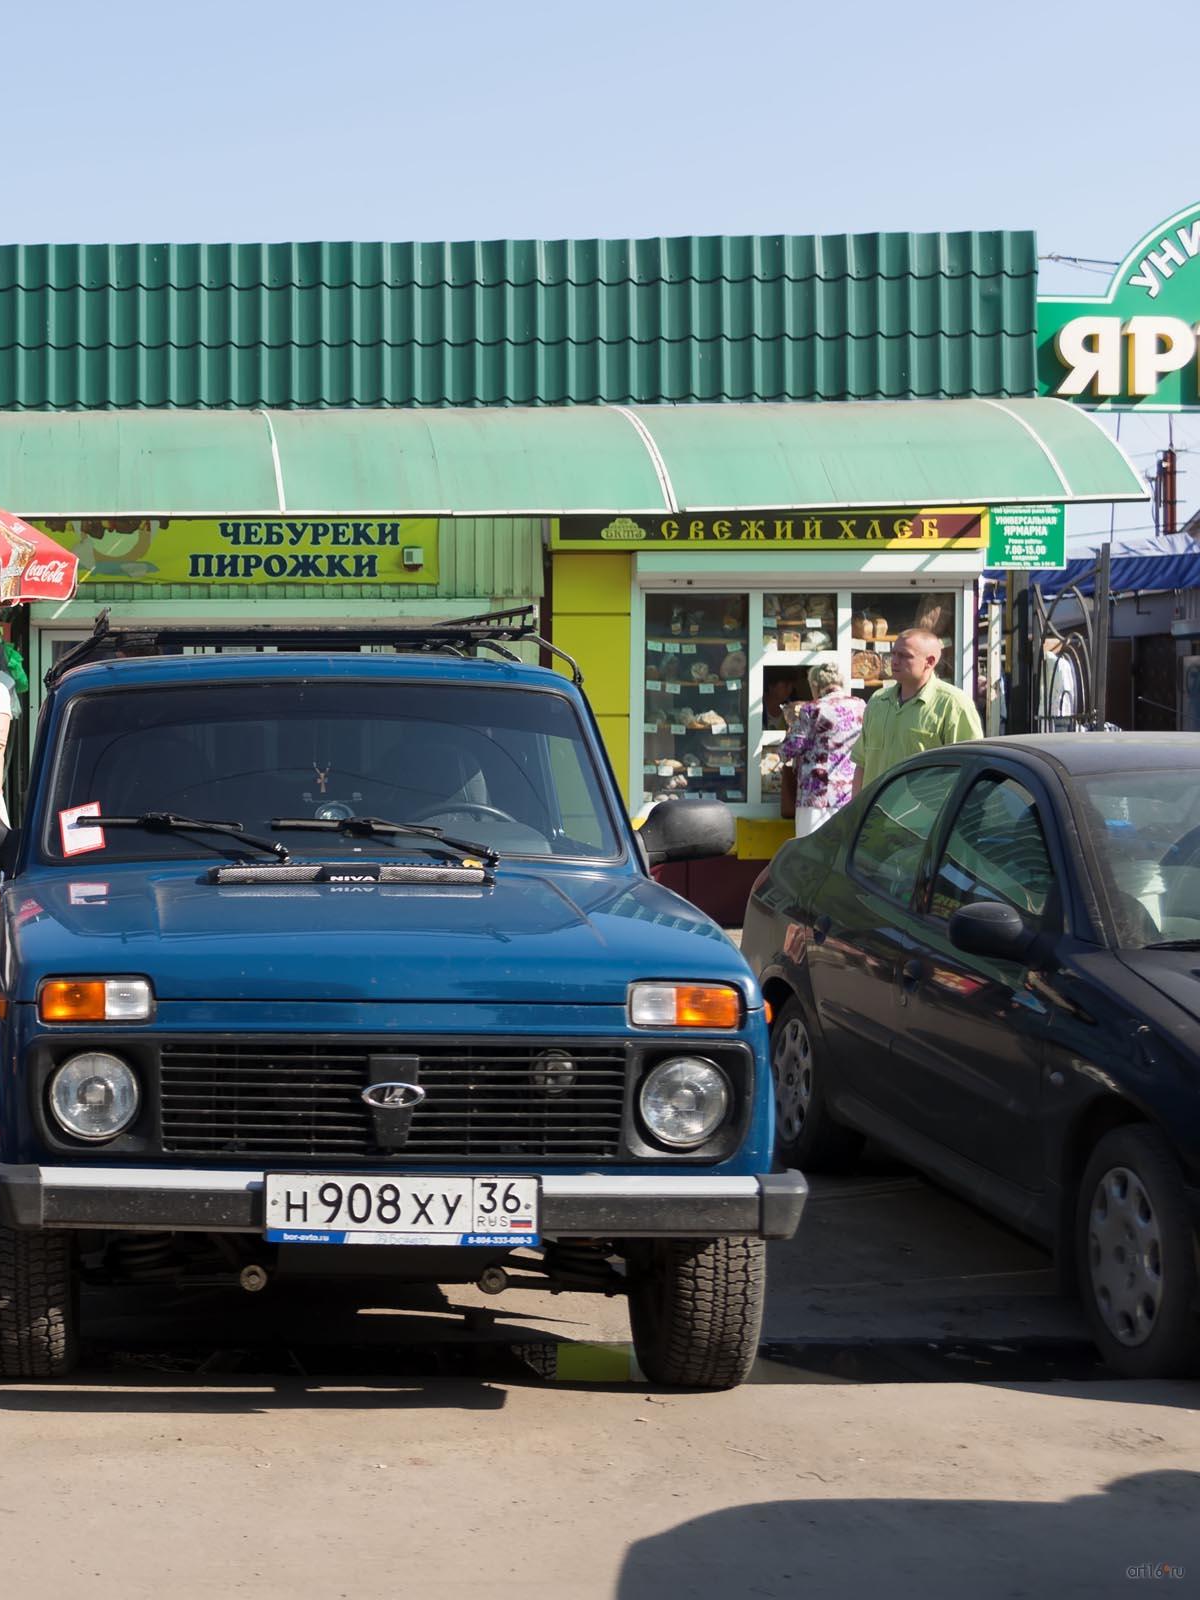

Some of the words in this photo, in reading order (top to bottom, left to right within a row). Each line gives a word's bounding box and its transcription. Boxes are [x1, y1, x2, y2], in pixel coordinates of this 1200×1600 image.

[661, 517, 824, 540] СВЕЖИЙ
[838, 518, 941, 540] ХЛЕБ
[995, 516, 1057, 525] УНИВЕРСАЛЬНАЯ
[1003, 525, 1049, 537] ЯРМАРКА
[218, 522, 400, 546] ЧЕБУРЕКИ
[188, 553, 379, 578] ПИРОЖКИ
[479, 1182, 521, 1214] 36
[477, 1215, 509, 1228] RUS
